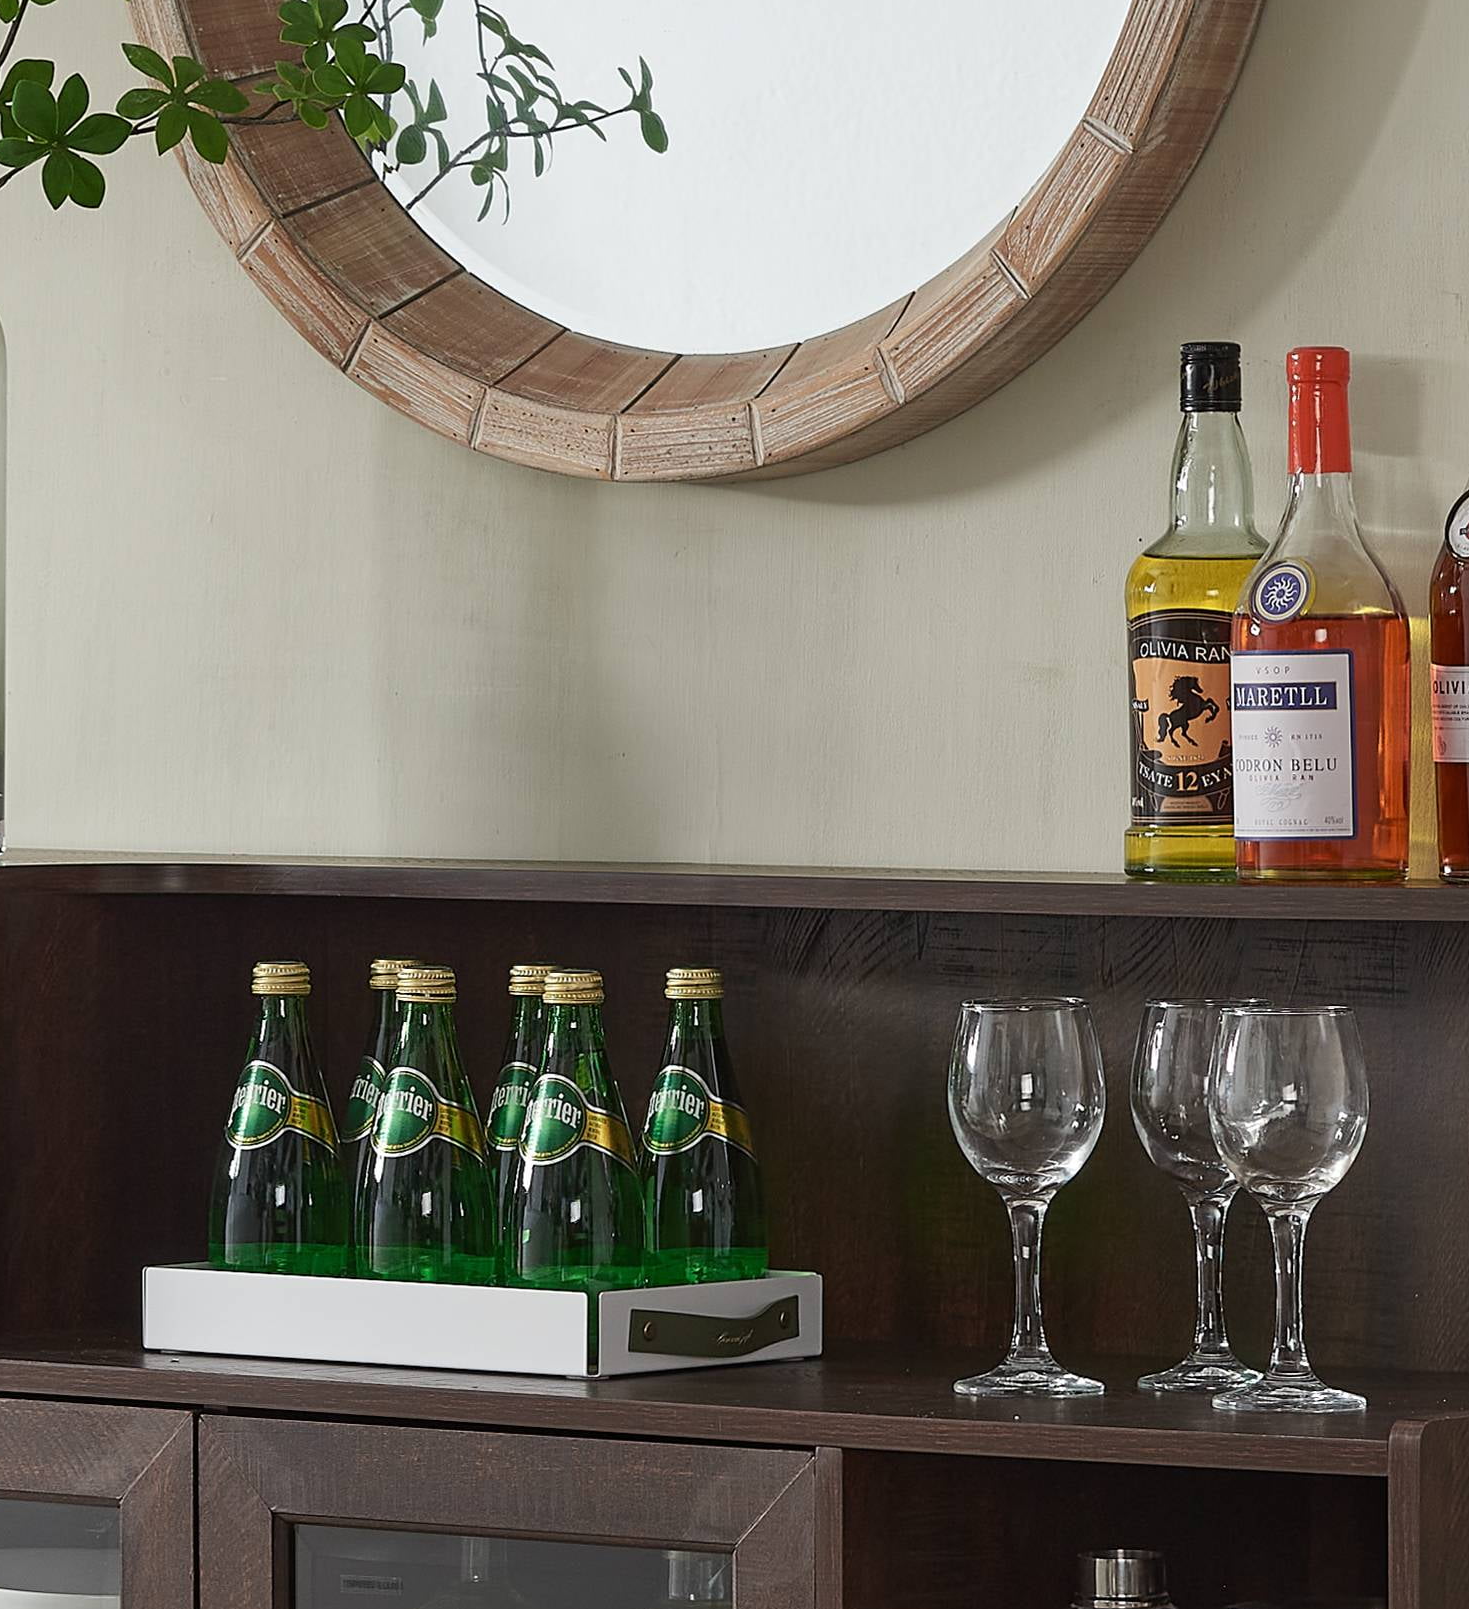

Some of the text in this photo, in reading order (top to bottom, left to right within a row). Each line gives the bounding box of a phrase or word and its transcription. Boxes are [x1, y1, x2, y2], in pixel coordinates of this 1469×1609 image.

[1140, 641, 1231, 661] OLIVIA RAN
[1236, 686, 1328, 707] MARETLL
[1291, 757, 1338, 772] BELU
[1177, 771, 1199, 792] 12
